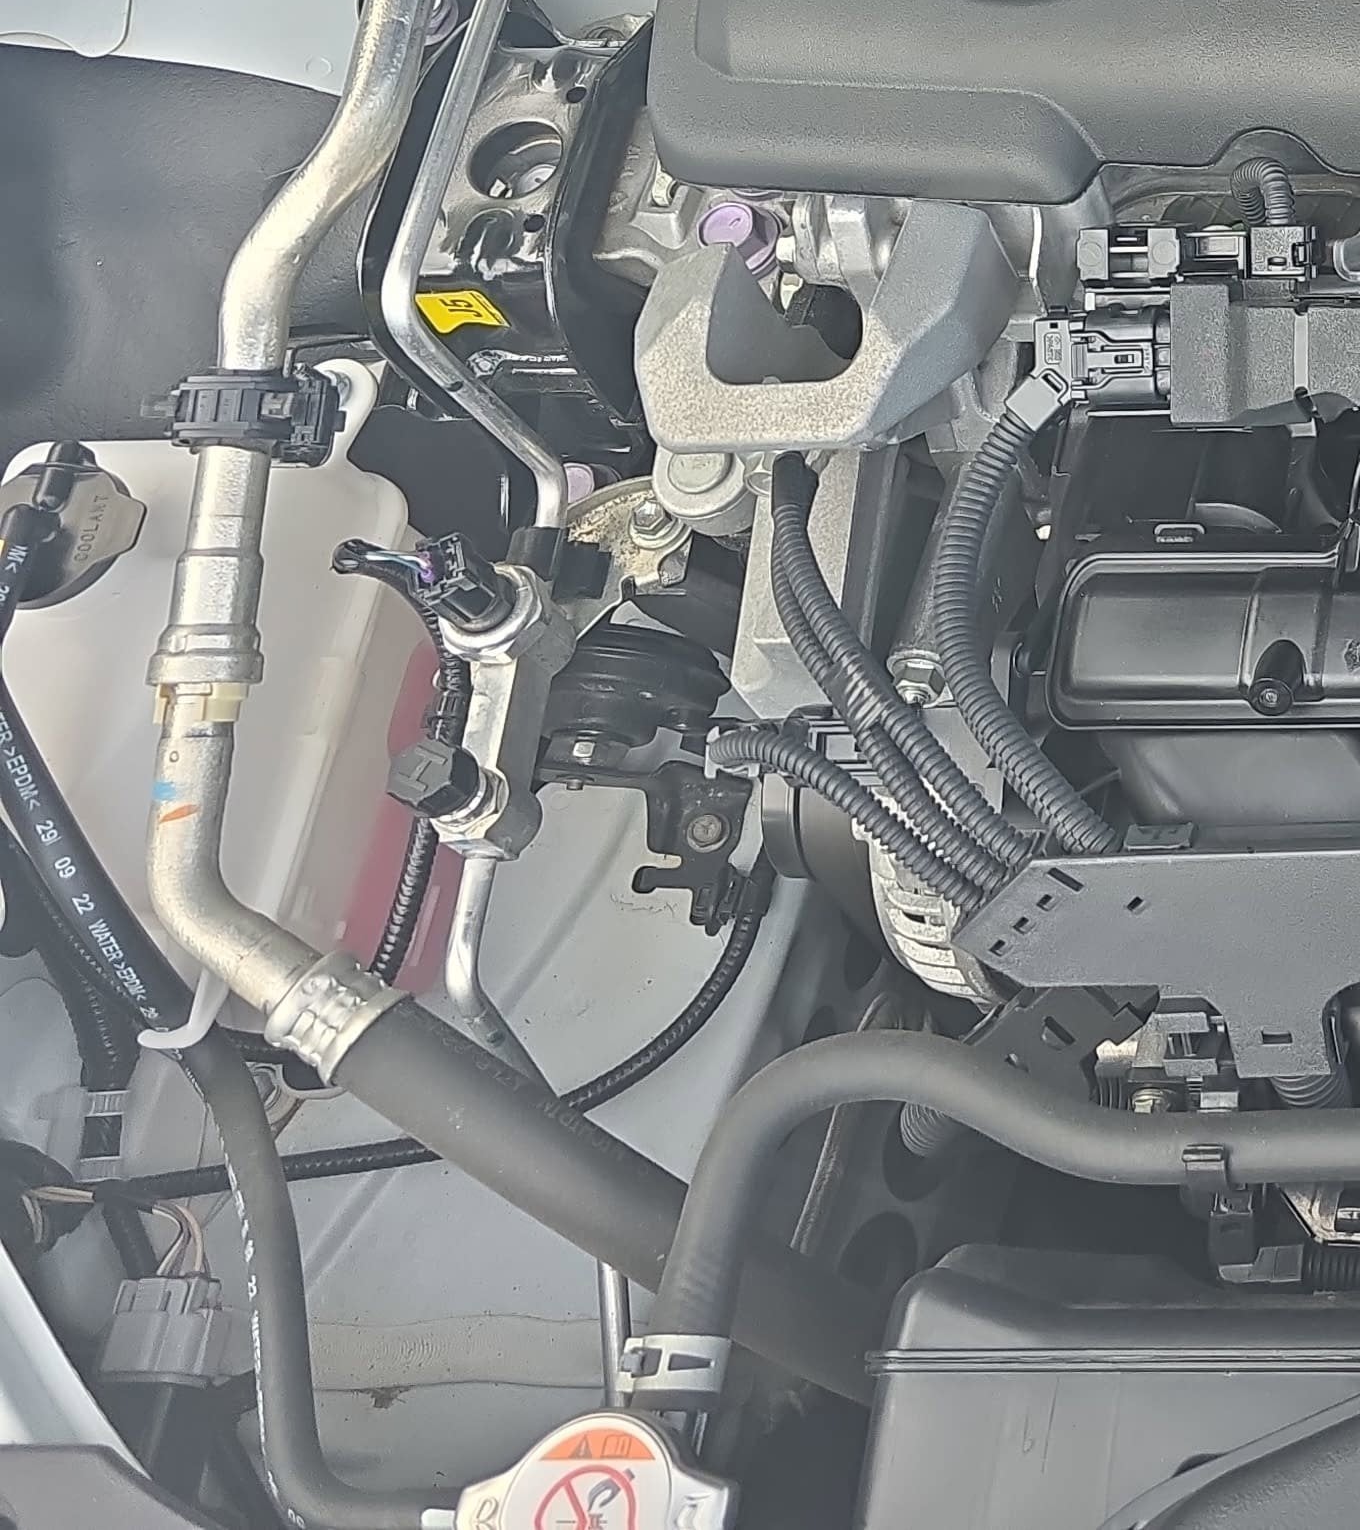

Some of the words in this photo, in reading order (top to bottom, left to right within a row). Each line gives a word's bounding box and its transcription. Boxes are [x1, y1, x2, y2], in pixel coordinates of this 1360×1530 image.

[445, 300, 480, 324] J5
[2, 744, 40, 811] >EPDM<
[53, 855, 76, 880] 09
[72, 891, 96, 917] 22
[88, 919, 123, 963] WATER
[112, 960, 147, 1009] >EPDM<
